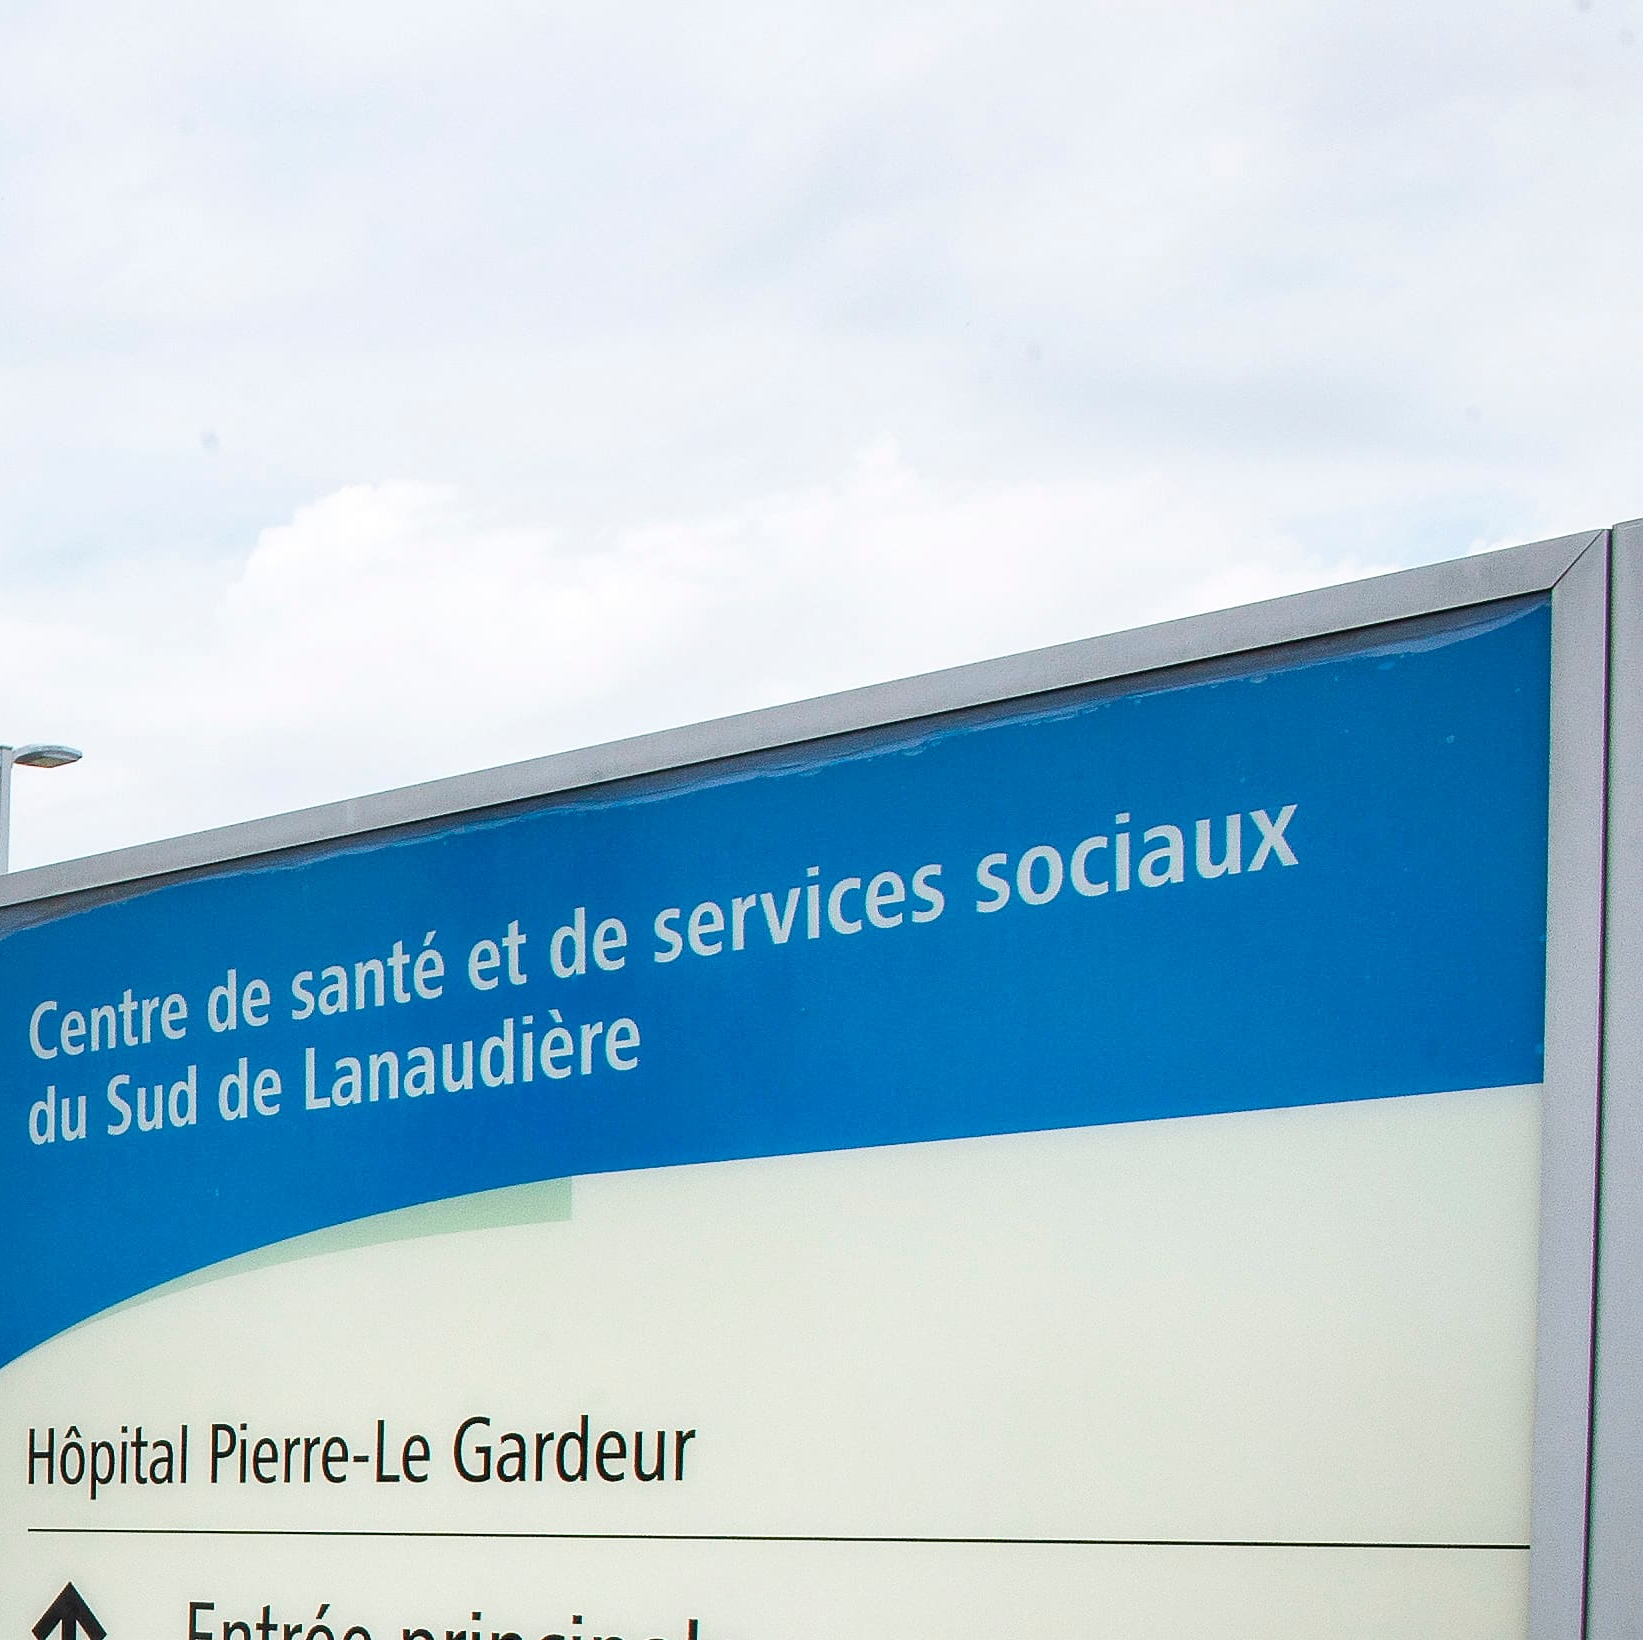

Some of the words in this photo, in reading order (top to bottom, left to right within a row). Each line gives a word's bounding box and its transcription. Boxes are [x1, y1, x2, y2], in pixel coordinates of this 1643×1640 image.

[29, 988, 188, 1060] Centre
[207, 968, 271, 1033] de
[291, 930, 445, 1020] santé
[468, 919, 527, 991] et
[550, 906, 628, 978] de
[654, 864, 945, 963] services
[976, 804, 1299, 913] sociaux
[29, 1085, 87, 1145] du
[107, 1064, 197, 1136] Sud
[218, 1056, 282, 1121] de
[305, 1008, 641, 1110] Lanaudière
[28, 1424, 188, 1501] Hôpital
[210, 1419, 431, 1484] Pierre-Le
[453, 1414, 697, 1483] Gardeur
